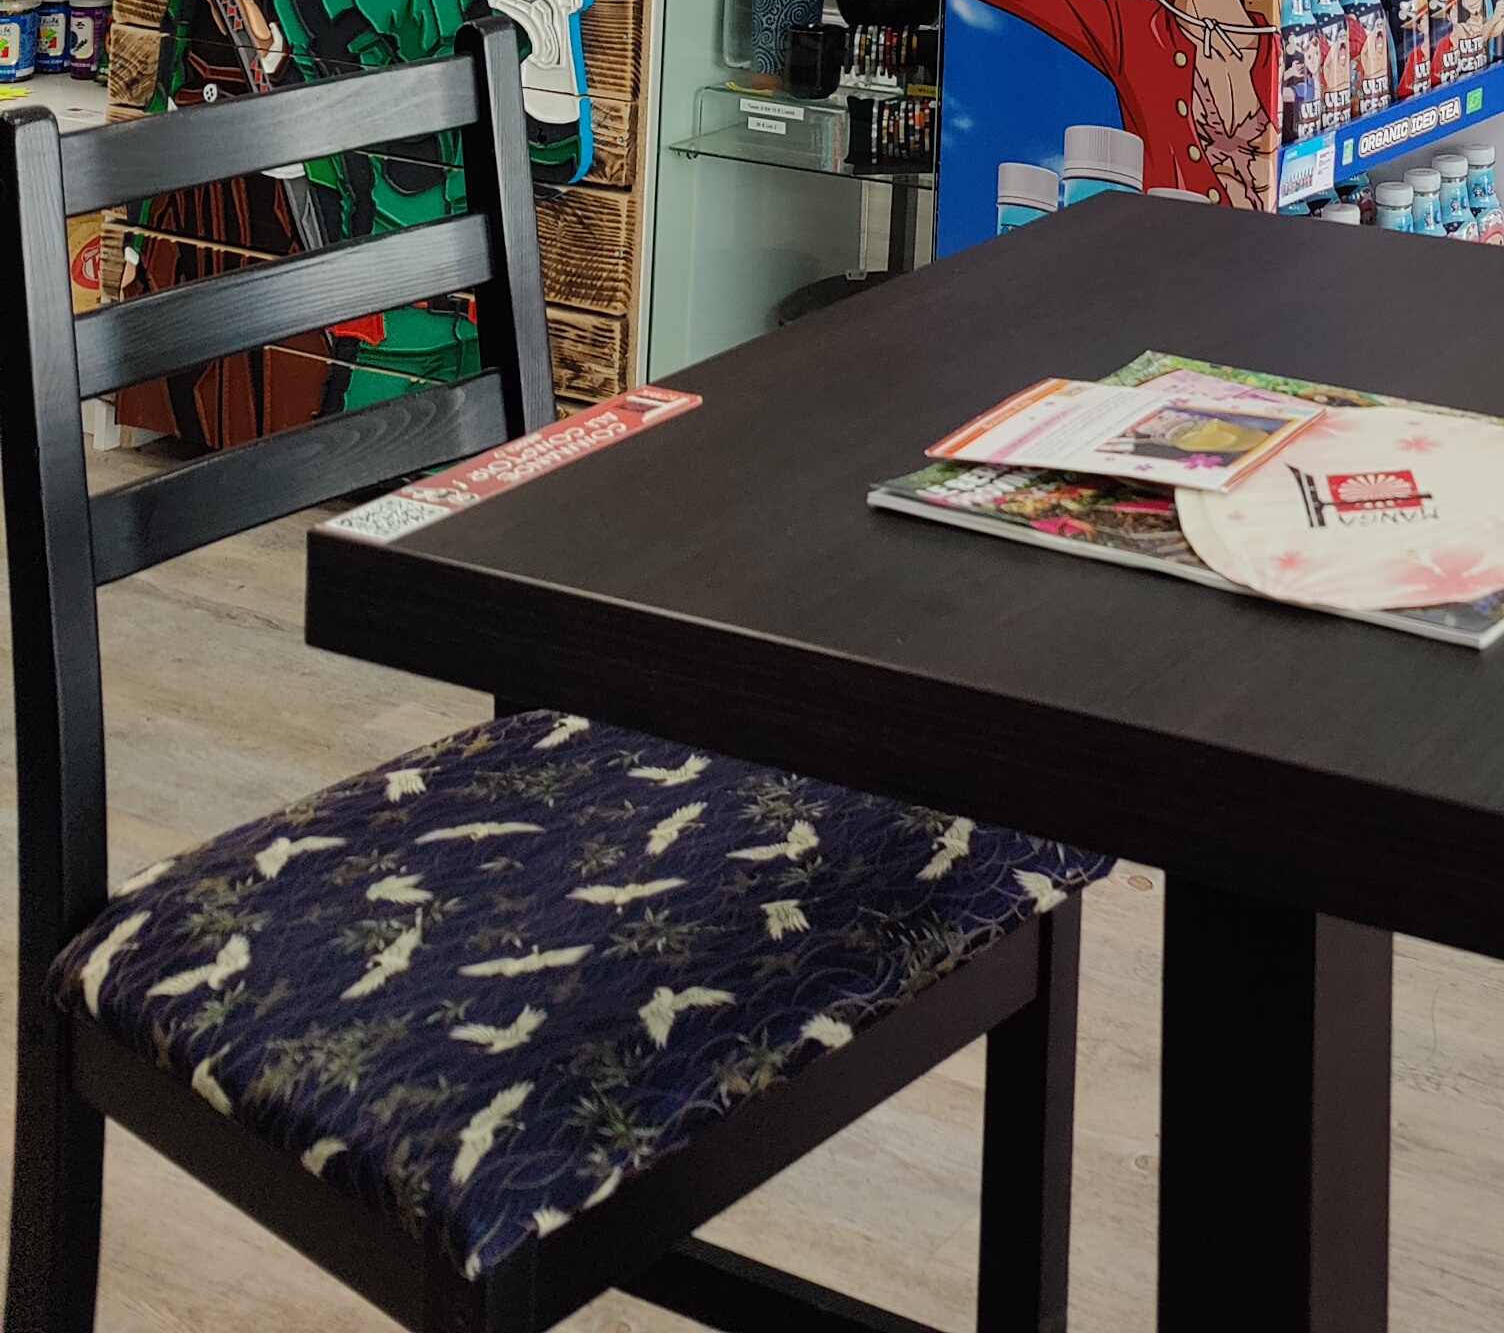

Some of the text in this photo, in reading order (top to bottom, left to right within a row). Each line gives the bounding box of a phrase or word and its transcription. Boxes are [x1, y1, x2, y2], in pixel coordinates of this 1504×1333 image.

[1359, 98, 1461, 156] ORGANIC ICED TEA
